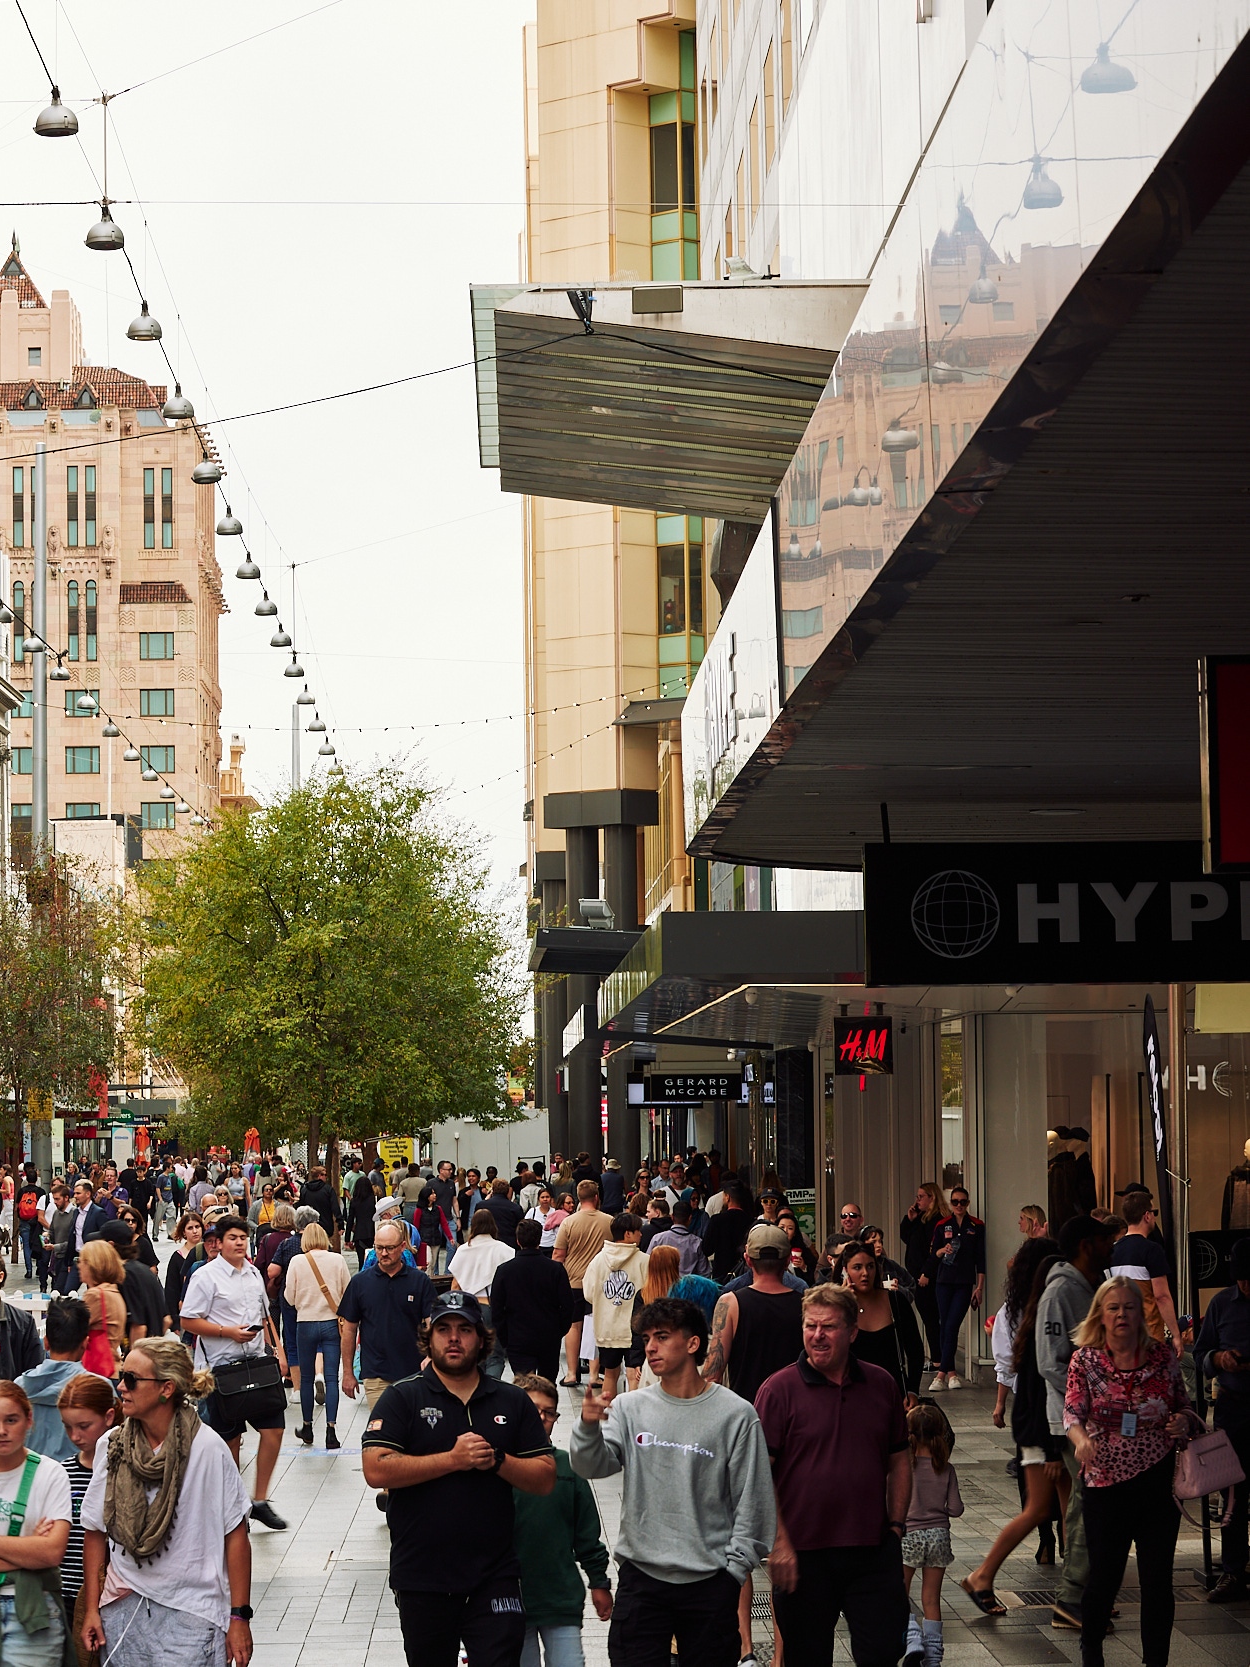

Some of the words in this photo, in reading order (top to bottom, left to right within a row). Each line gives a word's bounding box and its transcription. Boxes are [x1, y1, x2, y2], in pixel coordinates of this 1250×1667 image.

[1017, 881, 1250, 943] HYP
[839, 1029, 888, 1062] H&M
[664, 1078, 729, 1086] GERARD
[665, 1088, 728, 1096] McCABE
[1045, 1321, 1061, 1336] 20
[636, 1432, 714, 1458] Champion
